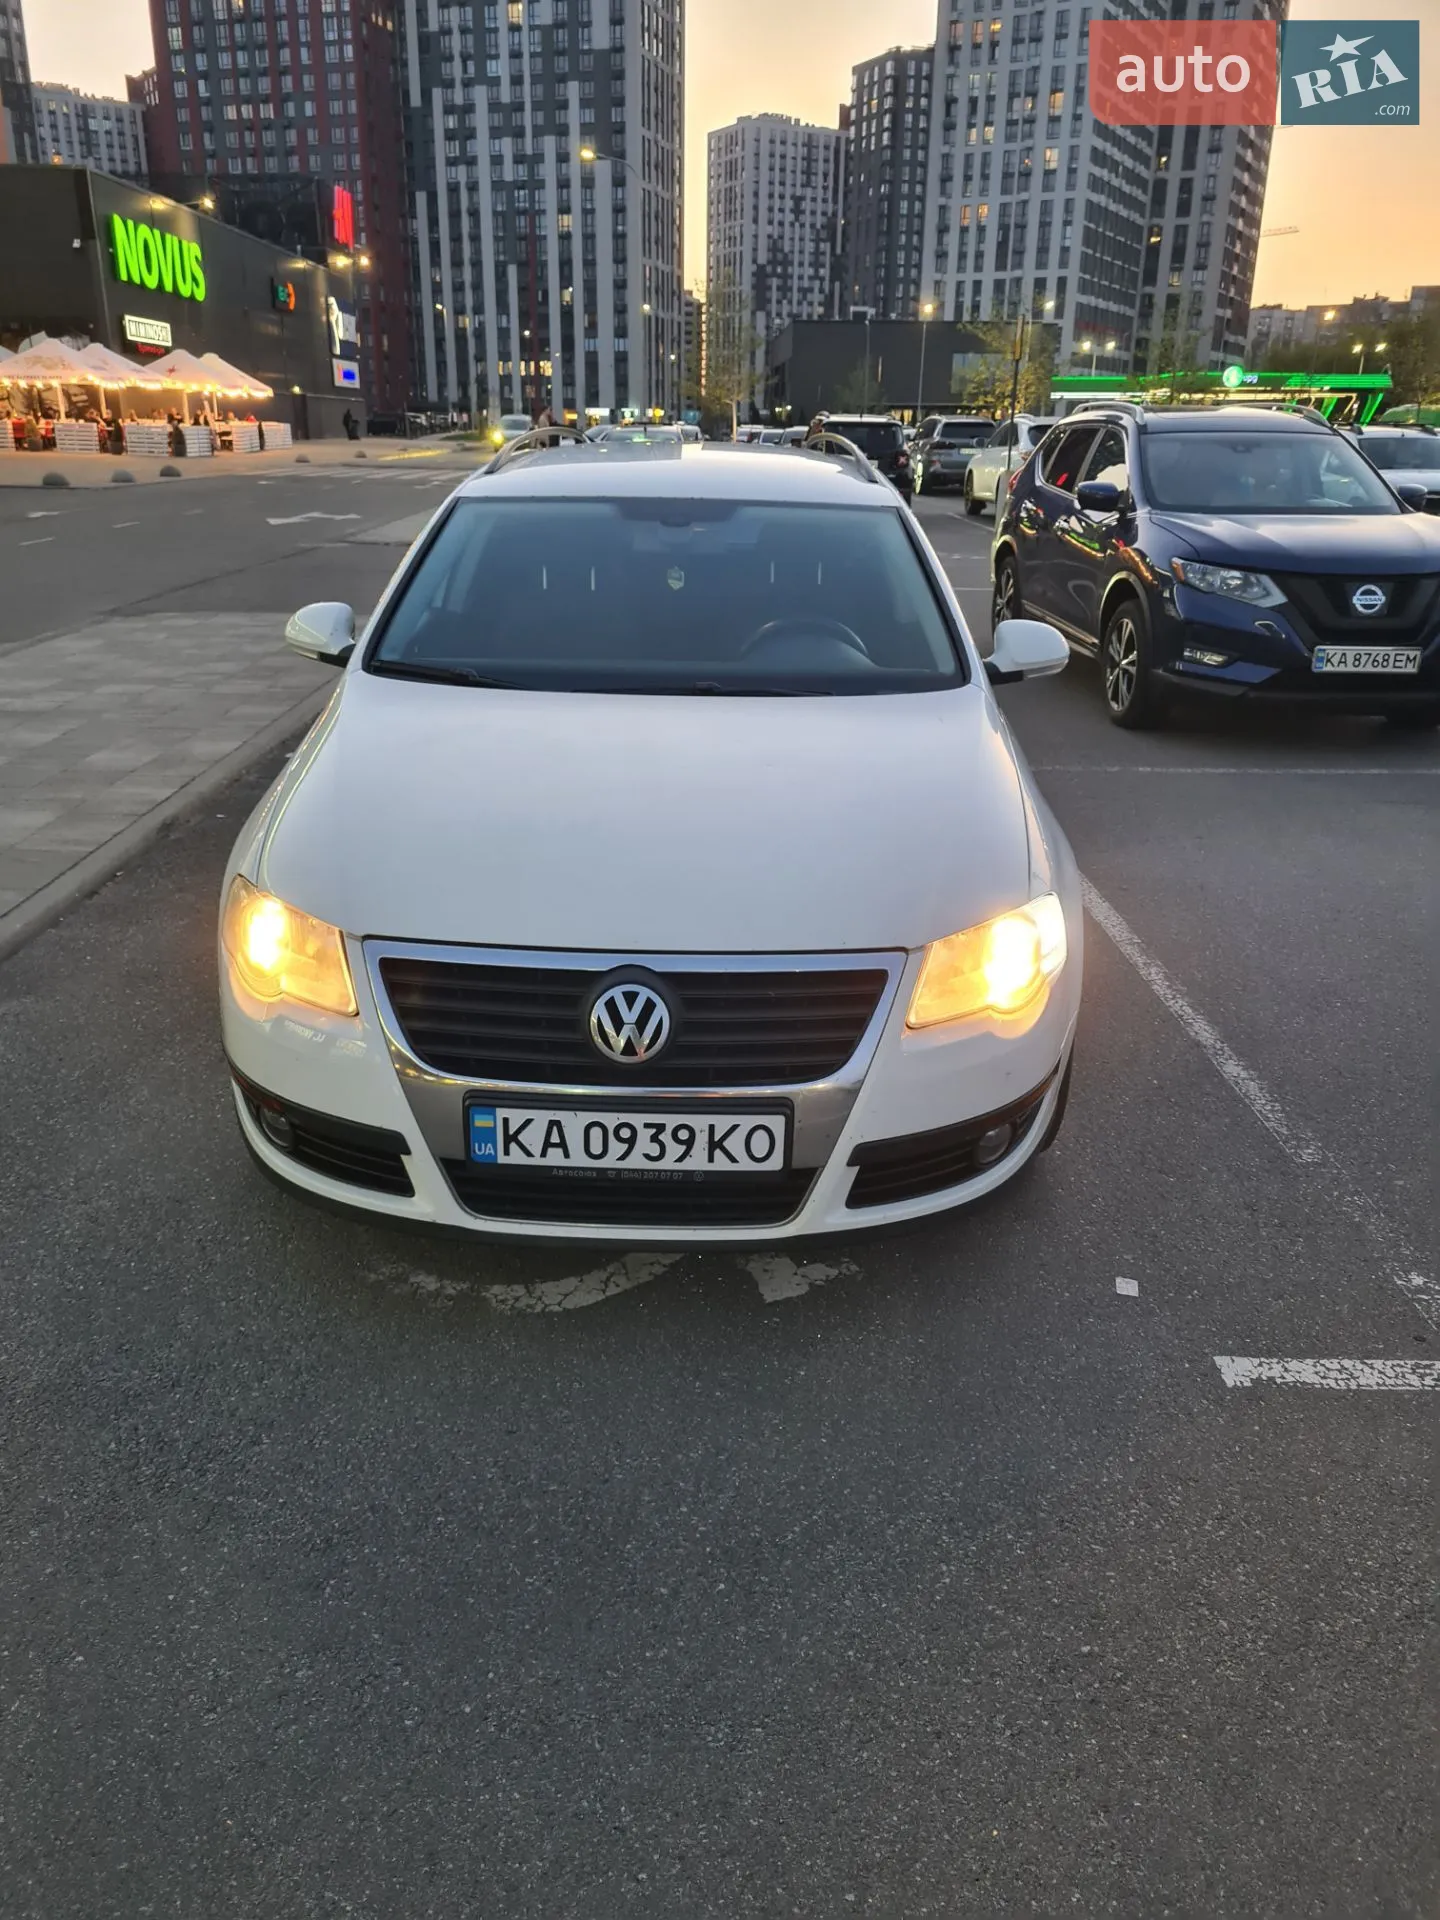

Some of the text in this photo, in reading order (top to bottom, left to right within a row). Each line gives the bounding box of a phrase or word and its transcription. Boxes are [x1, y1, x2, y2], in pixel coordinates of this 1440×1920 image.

[112, 213, 206, 302] NOVUS
[1325, 652, 1418, 669] KA 8768 EM
[475, 1142, 495, 1156] UA
[502, 1116, 776, 1164] KA 0939 KO
